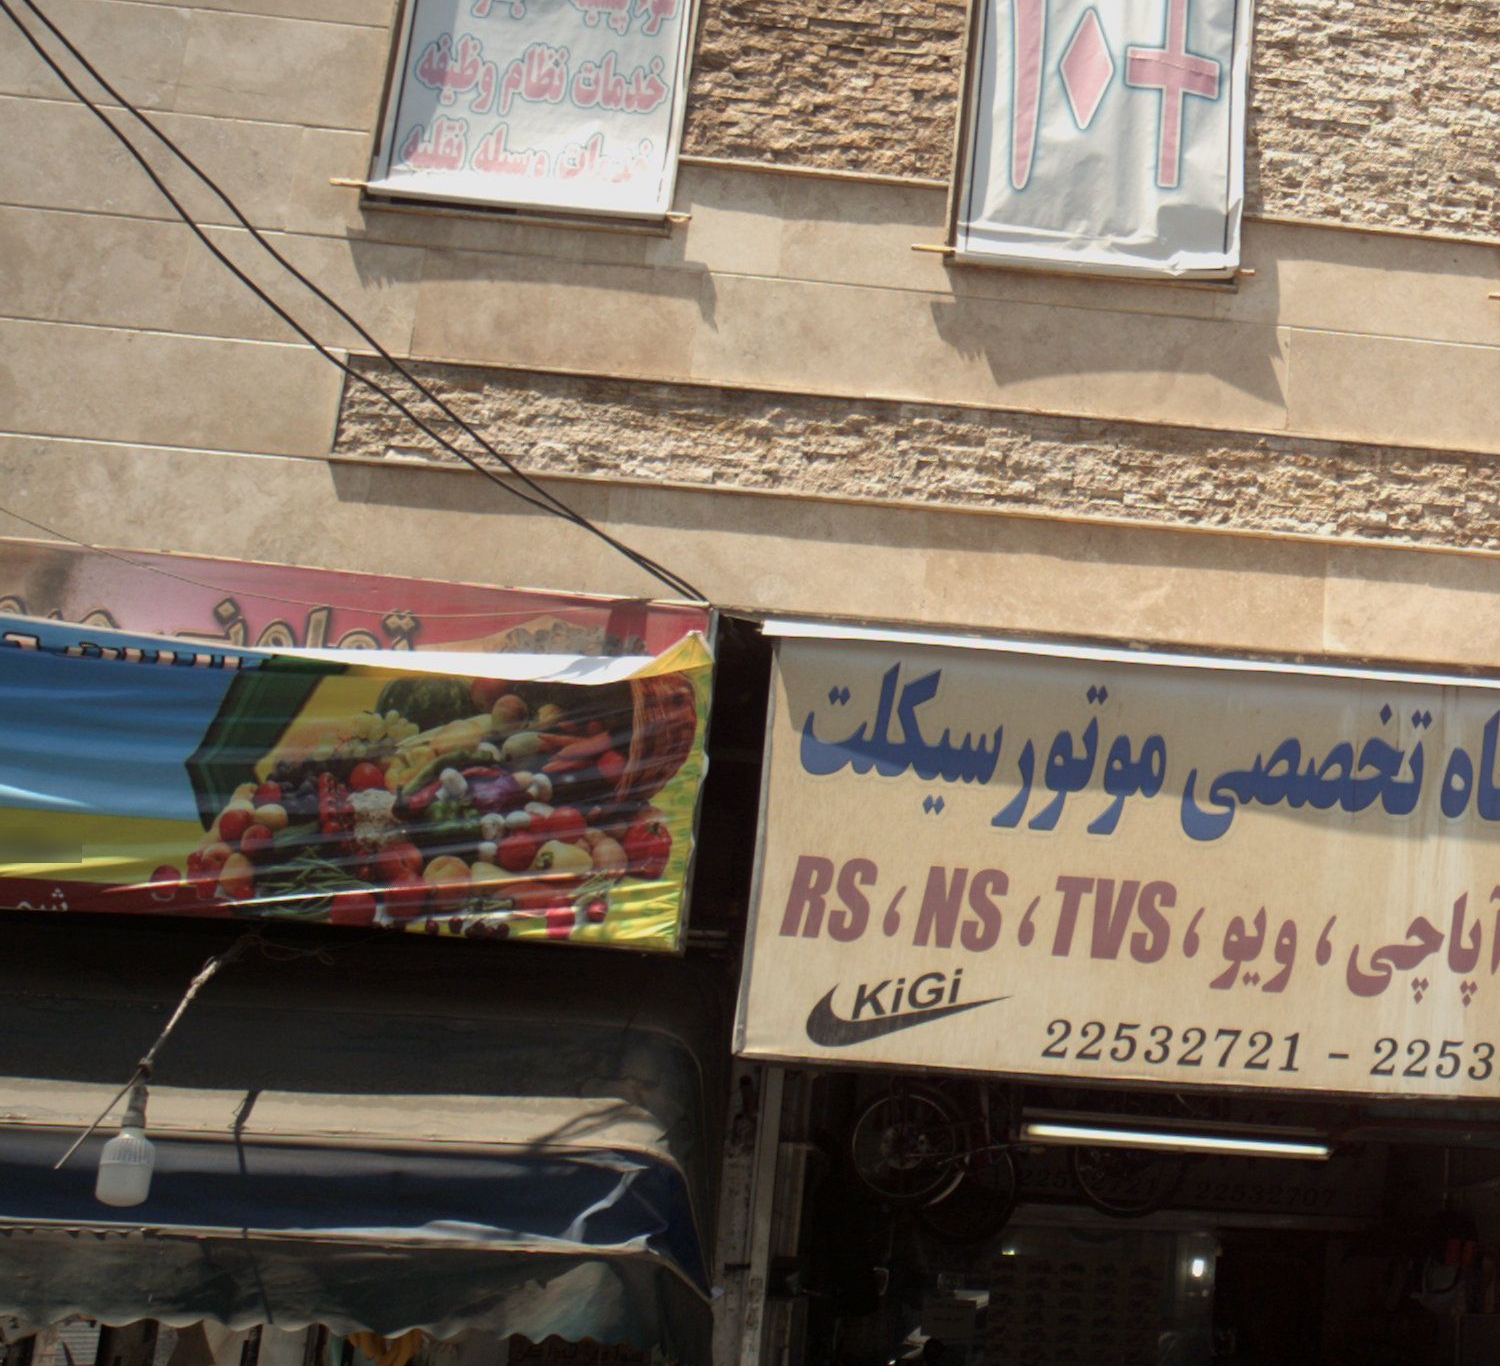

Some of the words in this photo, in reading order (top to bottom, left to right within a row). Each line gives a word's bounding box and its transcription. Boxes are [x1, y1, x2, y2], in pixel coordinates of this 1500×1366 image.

[415, 32, 497, 113] وظیفه
[498, 41, 569, 115] نظام
[571, 50, 669, 113] خدمات
[1180, 703, 1432, 841] تخصصی
[779, 855, 878, 942] RS
[852, 969, 963, 1020] KiGi
[1041, 1019, 1300, 1073] 22532721
